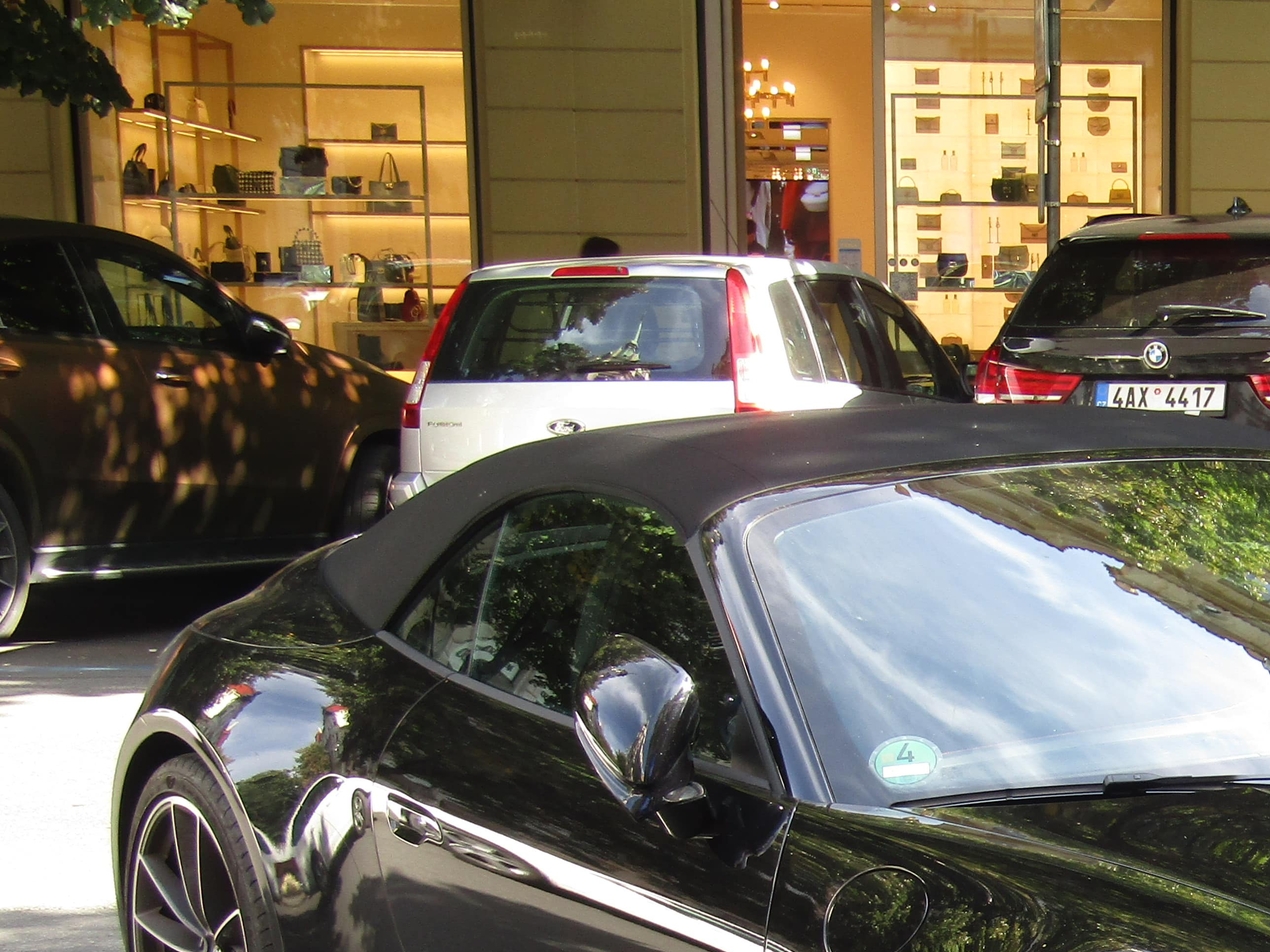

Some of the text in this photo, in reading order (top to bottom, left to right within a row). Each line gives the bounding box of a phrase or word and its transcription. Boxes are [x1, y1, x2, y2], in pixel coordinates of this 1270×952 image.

[1112, 386, 1149, 408] 4AX
[1164, 386, 1216, 408] 4417
[896, 742, 915, 763] 4
